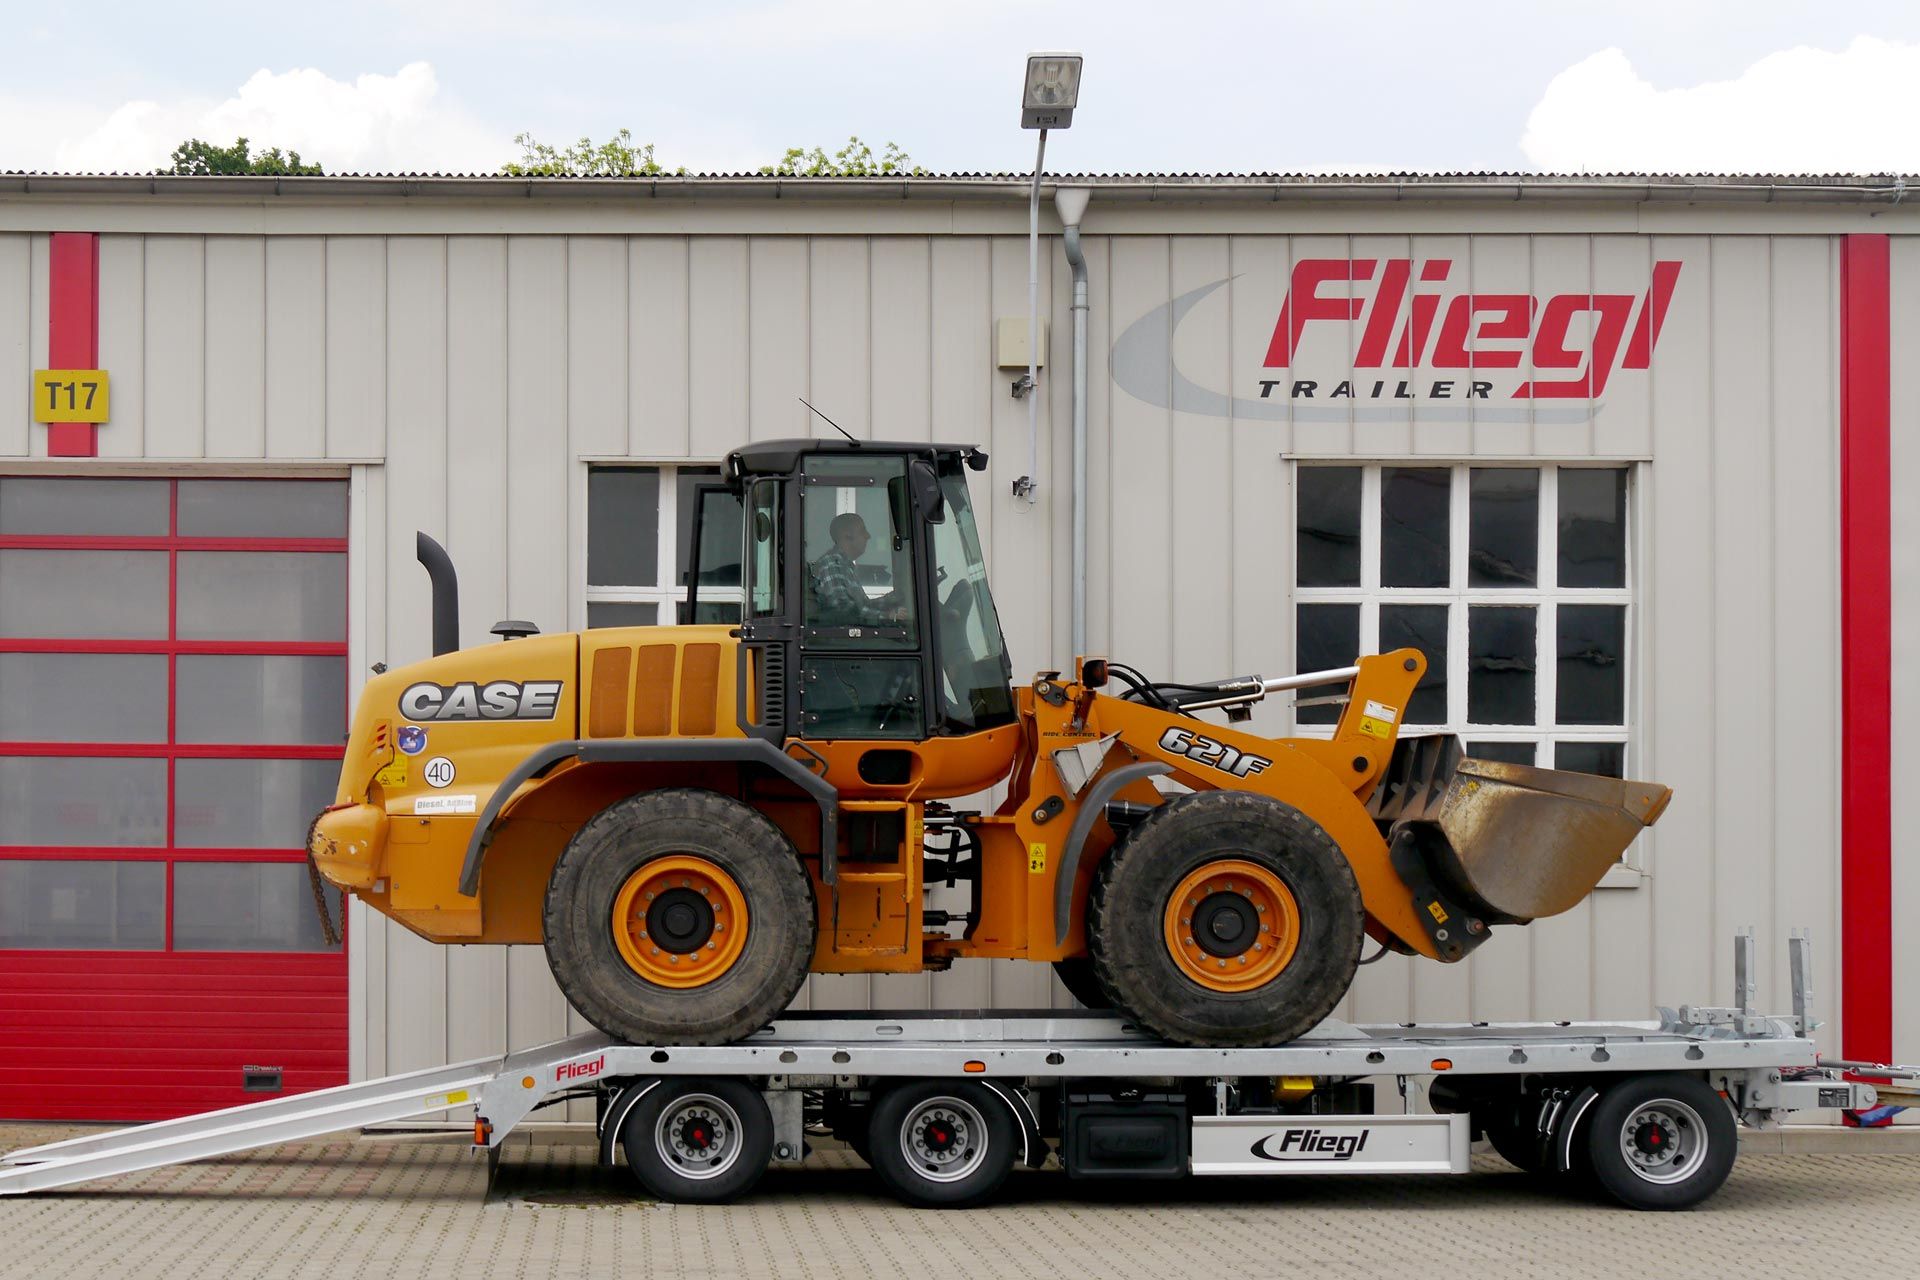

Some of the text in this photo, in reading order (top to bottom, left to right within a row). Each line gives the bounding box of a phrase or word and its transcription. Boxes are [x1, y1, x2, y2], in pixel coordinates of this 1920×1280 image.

[1262, 259, 1683, 399] Fliegl
[44, 381, 98, 410] T17
[1258, 380, 1493, 399] TRAILER
[399, 681, 562, 721] CASE
[1159, 726, 1273, 778] 621F
[428, 762, 451, 783] 40
[555, 1055, 605, 1082] Fliegl
[1278, 1128, 1370, 1158] Fliegl
